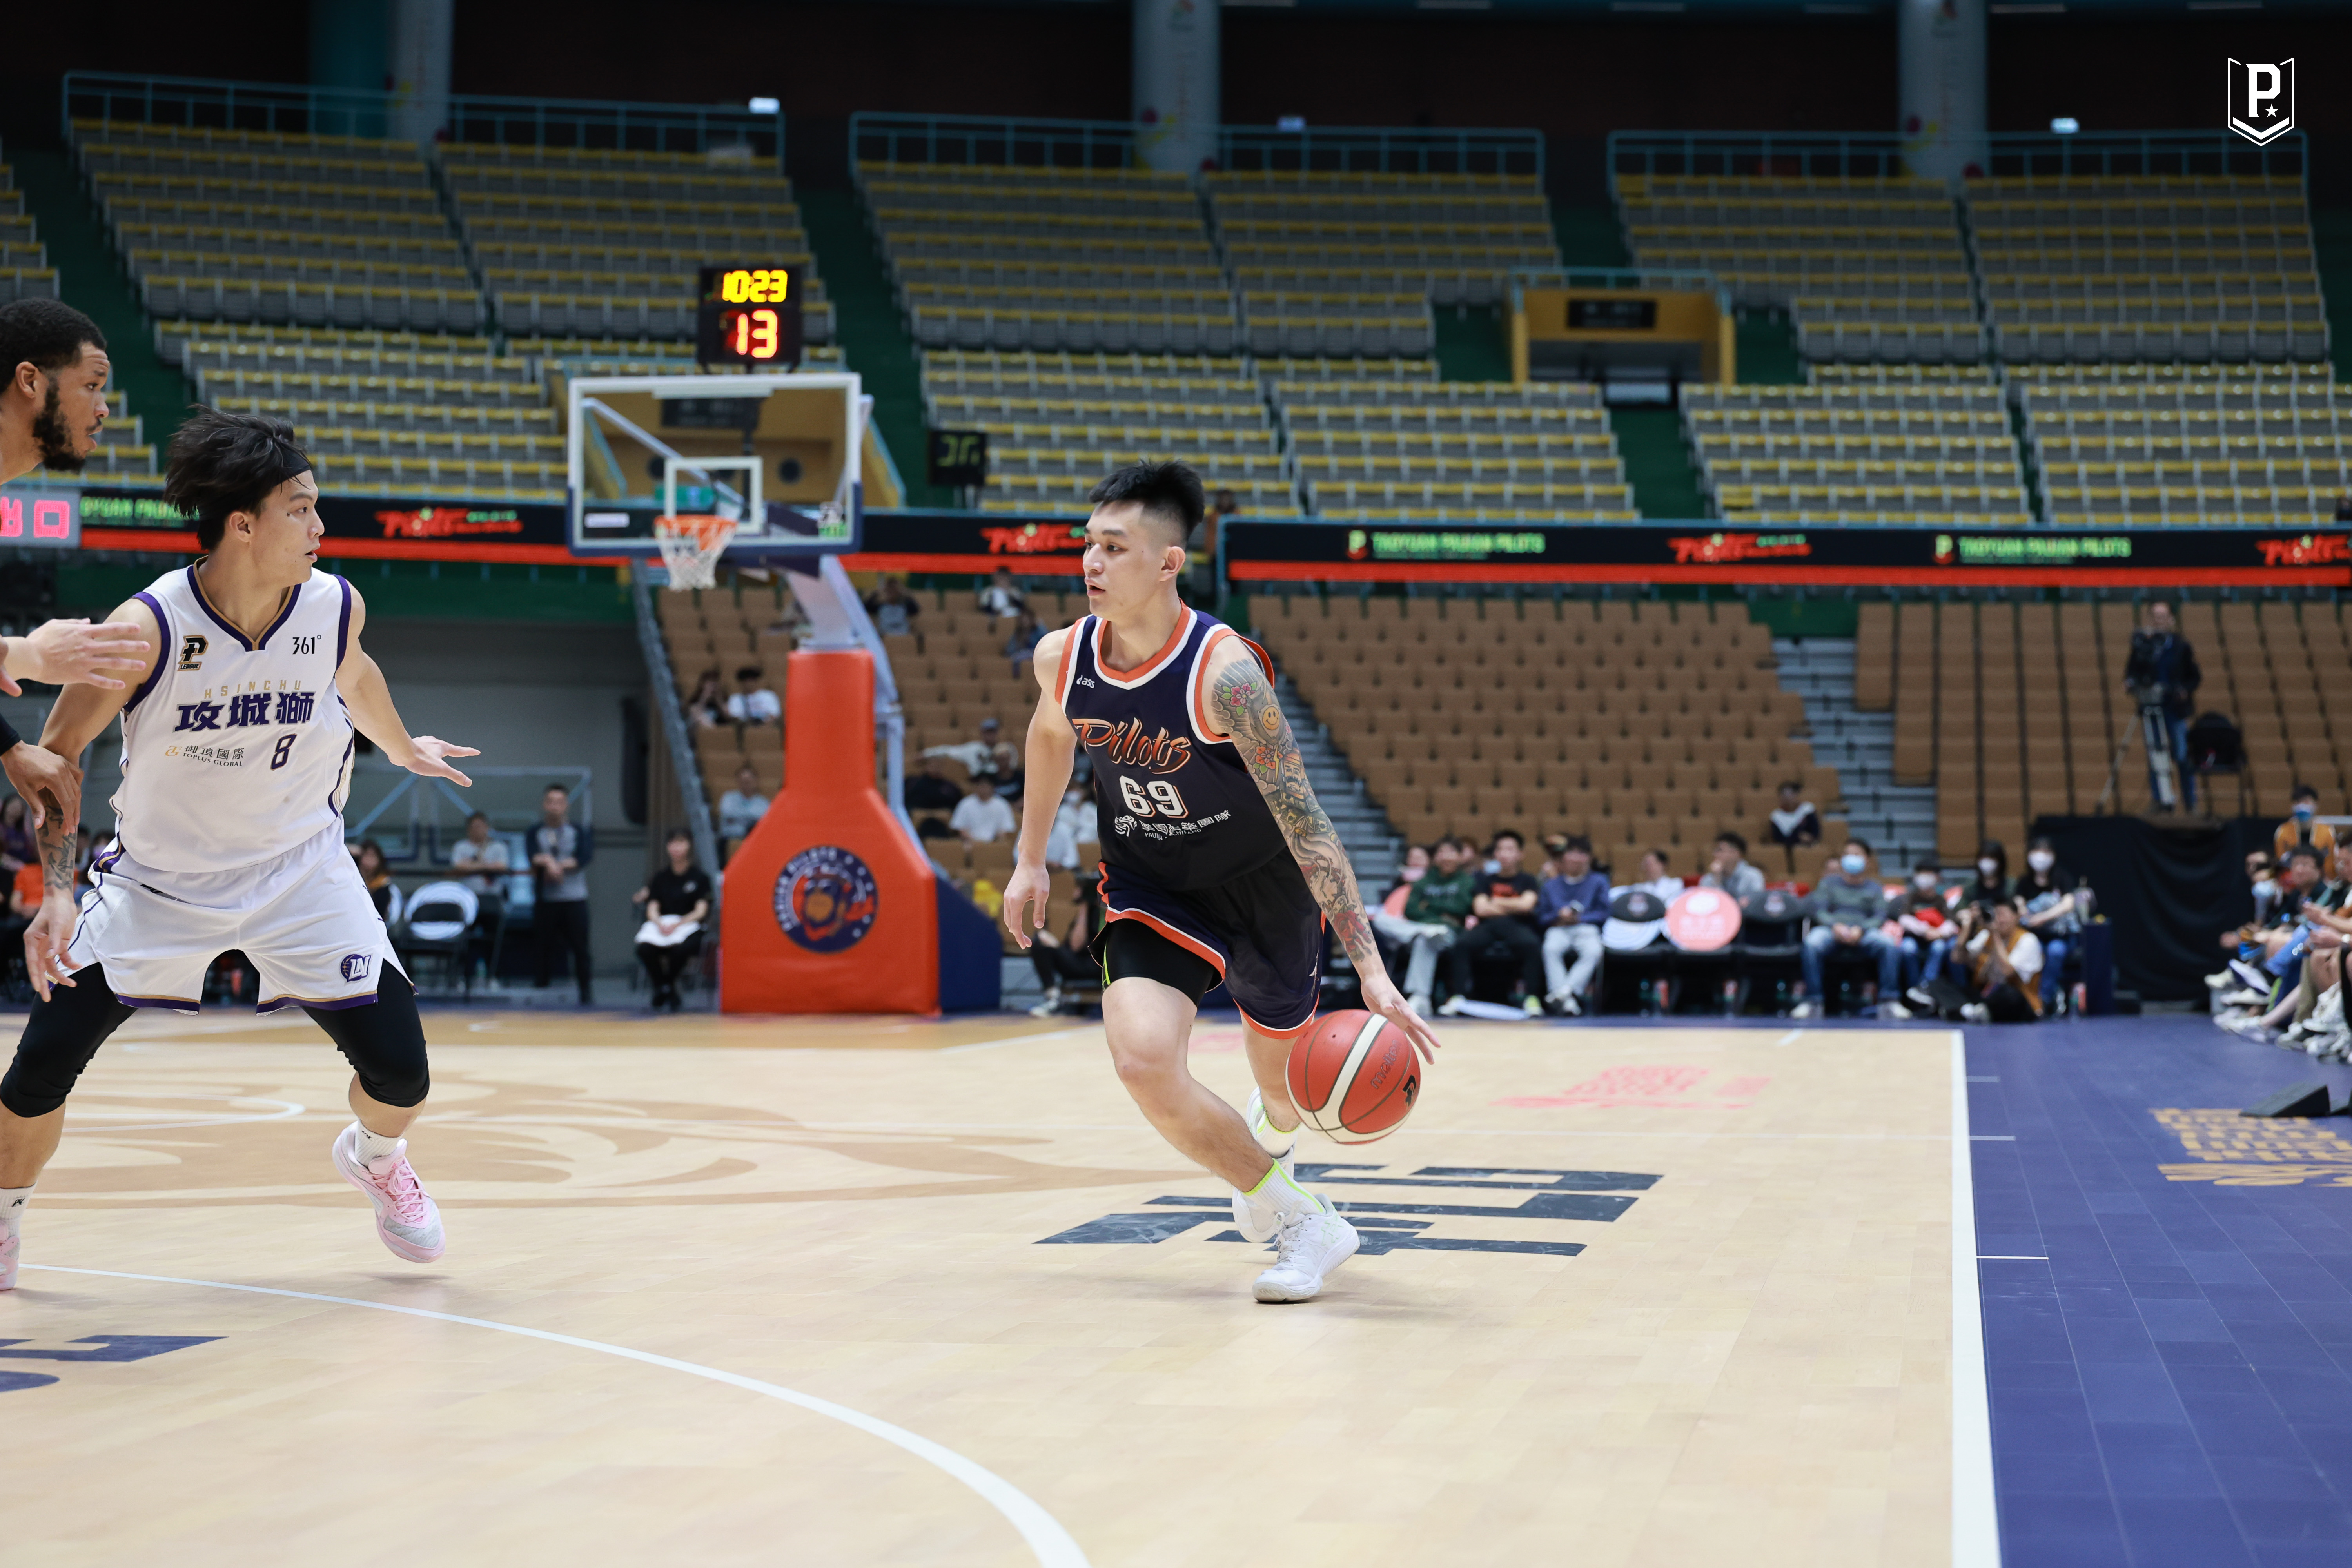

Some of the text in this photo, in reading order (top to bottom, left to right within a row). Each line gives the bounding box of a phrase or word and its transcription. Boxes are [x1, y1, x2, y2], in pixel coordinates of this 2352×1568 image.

[736, 309, 778, 358] 13
[292, 634, 321, 655] 361°
[204, 679, 301, 699] HSINCHU
[172, 691, 316, 733] 攻城獅
[183, 752, 211, 763] TOPLUS
[185, 745, 245, 760] 御頂國際
[270, 733, 297, 771] 8
[1072, 717, 1192, 775] Pilots
[1119, 775, 1189, 818] 69
[1370, 1039, 1402, 1089] molten
